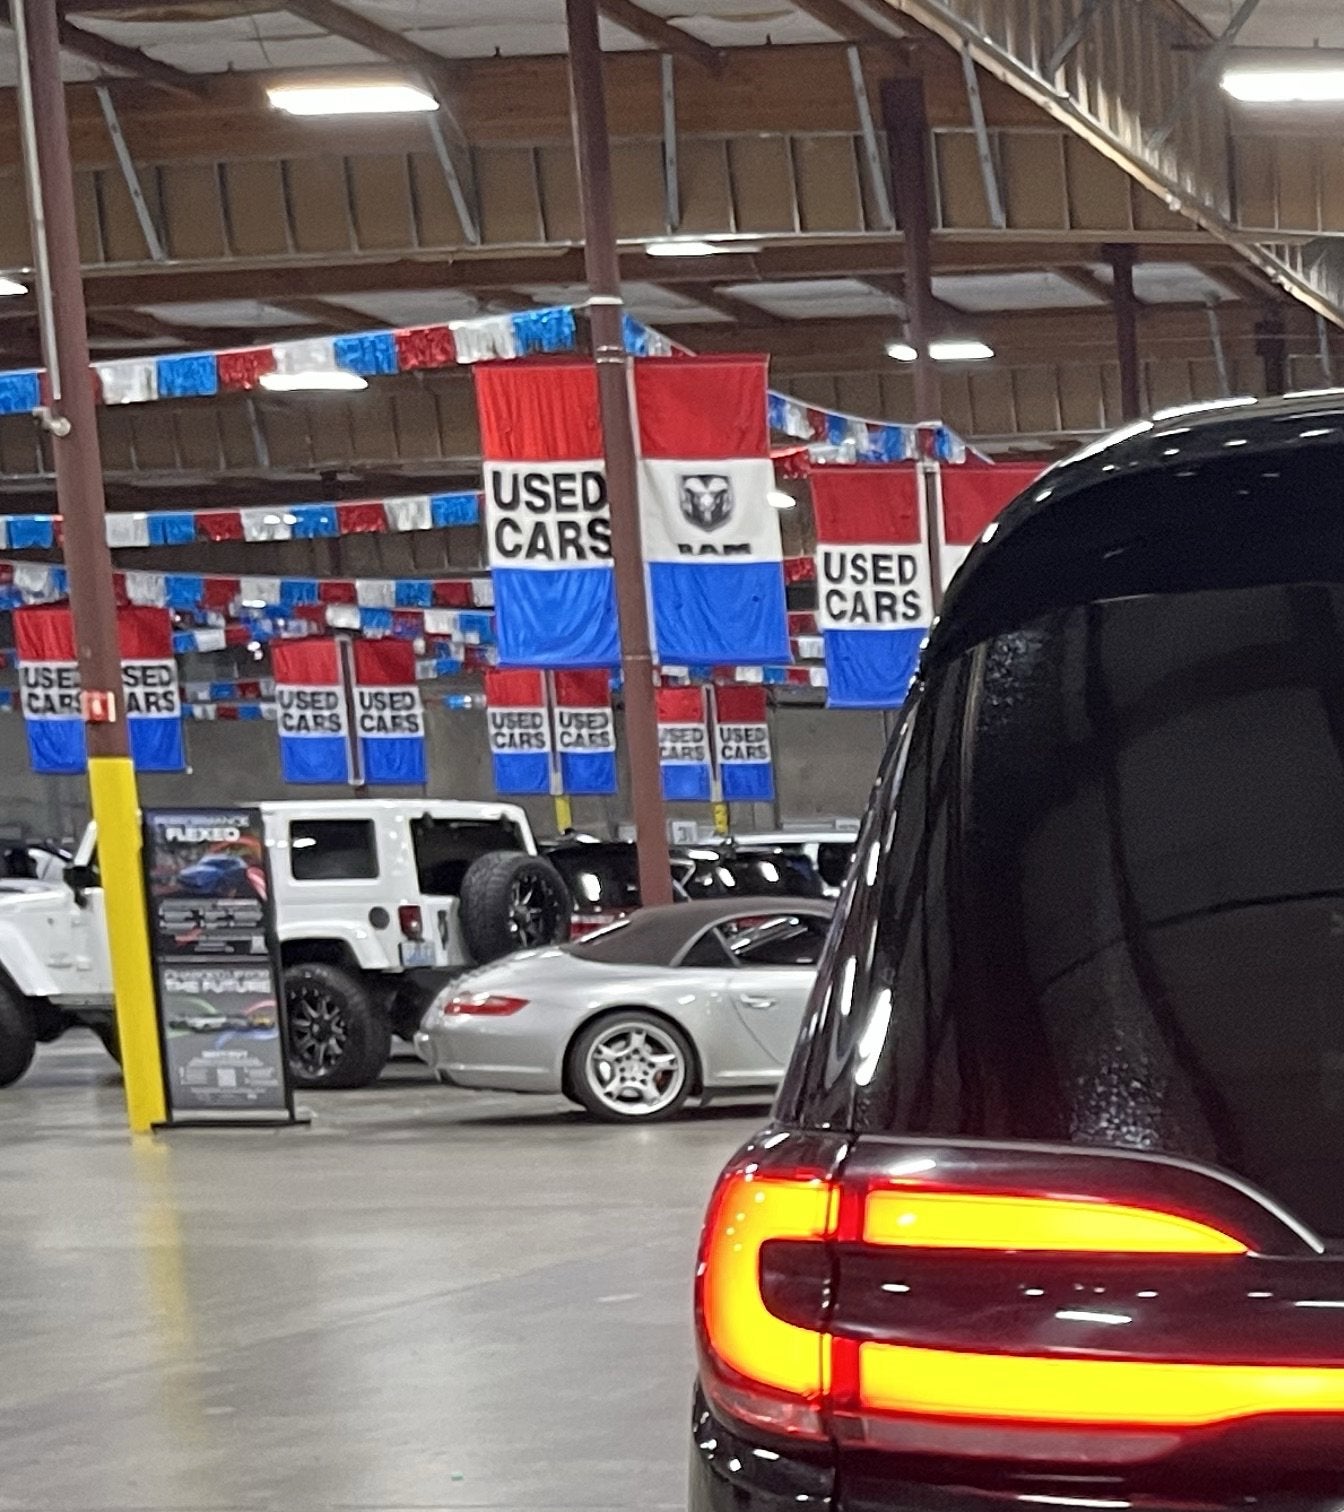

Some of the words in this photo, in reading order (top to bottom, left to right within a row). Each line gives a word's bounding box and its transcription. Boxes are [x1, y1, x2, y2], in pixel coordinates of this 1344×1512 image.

[492, 471, 607, 514] USED
[494, 517, 611, 560] CARS
[824, 552, 917, 585] USED
[825, 589, 921, 623] CARS
[123, 665, 173, 688] SED
[126, 691, 175, 714] ARS
[278, 690, 339, 711] USED
[358, 691, 417, 711] USED
[281, 713, 342, 733] CARS
[359, 713, 420, 733] CARS
[492, 712, 543, 730] USED
[559, 711, 609, 729] USED
[493, 731, 546, 748] CARS
[560, 731, 611, 748] CARS
[719, 727, 766, 743] USED
[721, 745, 768, 760] CARS
